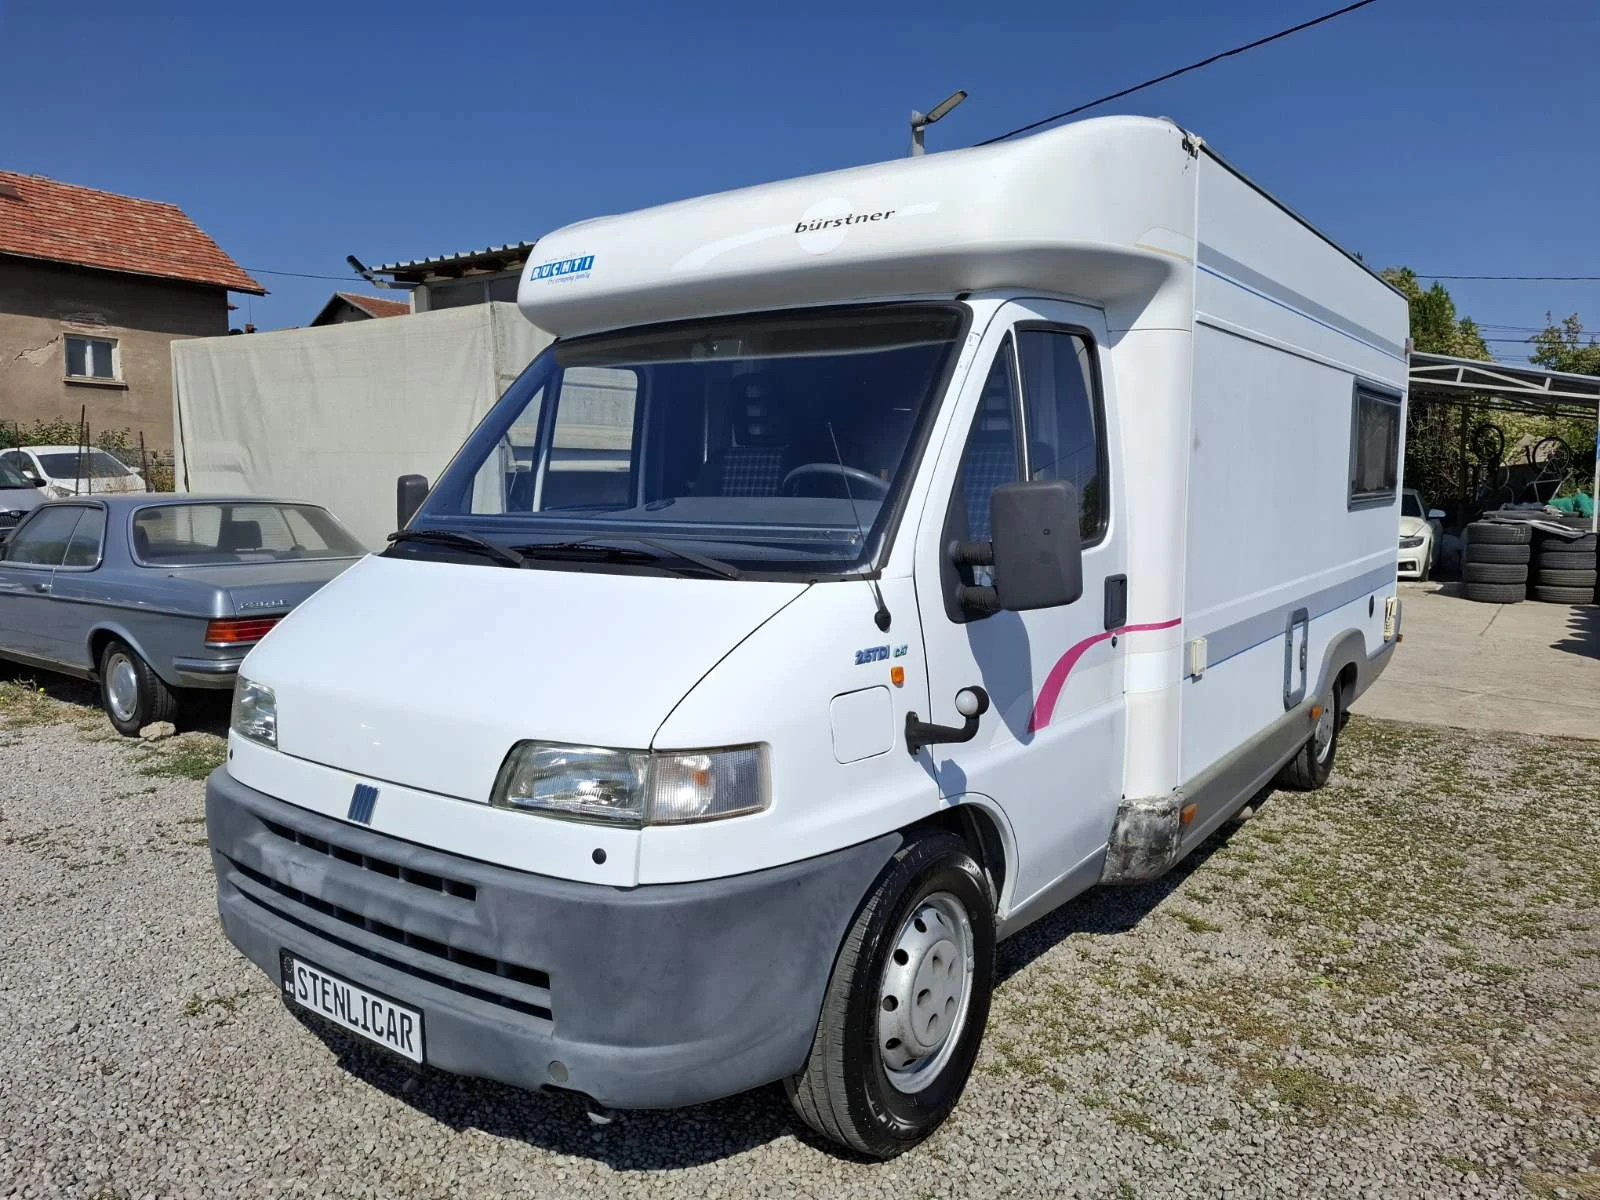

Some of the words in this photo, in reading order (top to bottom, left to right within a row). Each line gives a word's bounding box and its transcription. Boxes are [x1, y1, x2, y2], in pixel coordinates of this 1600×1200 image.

[795, 210, 895, 234] bürstner
[531, 256, 594, 281] RUCHTI
[297, 966, 414, 1053] STENLICAR
